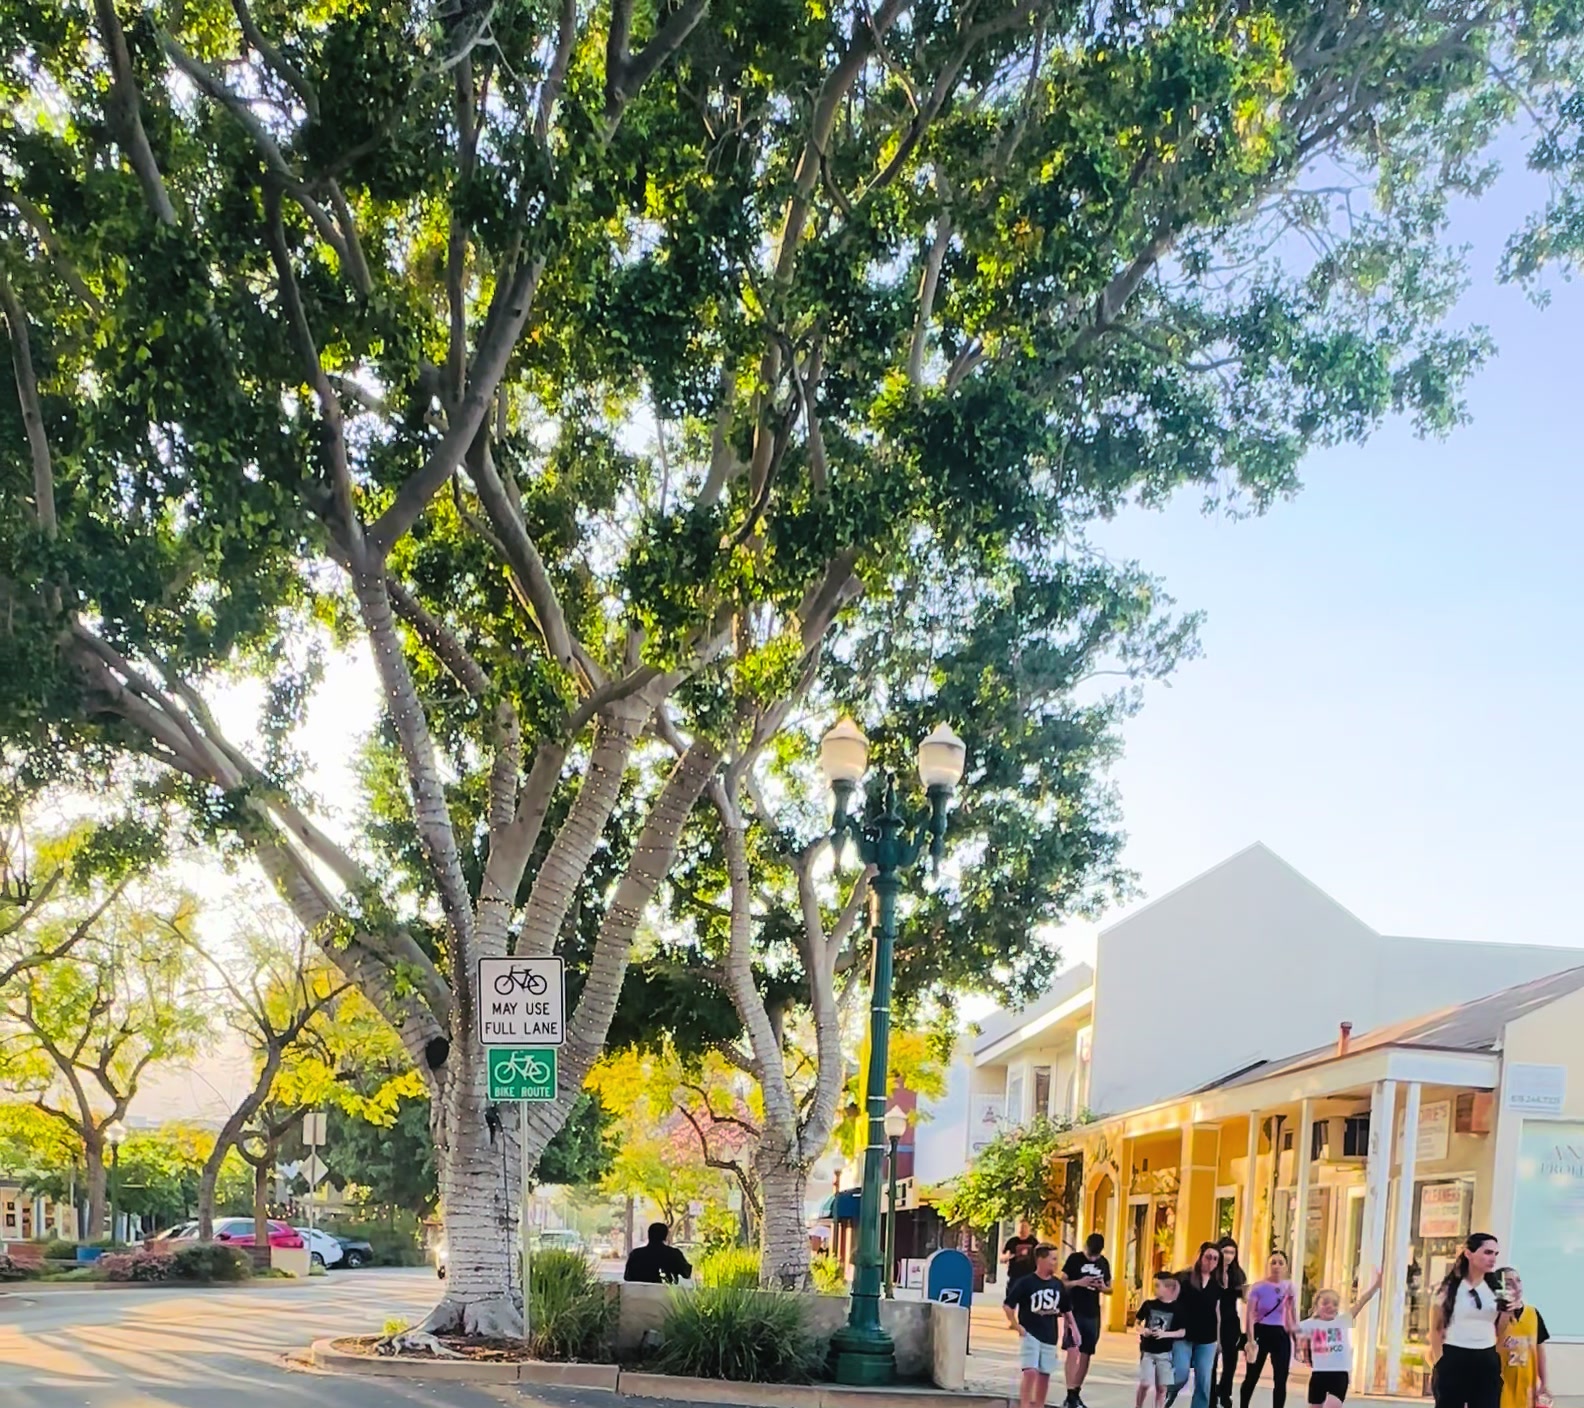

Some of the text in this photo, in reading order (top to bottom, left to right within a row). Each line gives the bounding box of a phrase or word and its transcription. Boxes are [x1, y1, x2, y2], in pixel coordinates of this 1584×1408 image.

[492, 1002, 550, 1015] MAY USE
[485, 1022, 558, 1035] FULL LANE
[494, 1086, 551, 1097] BIKE ROUTE
